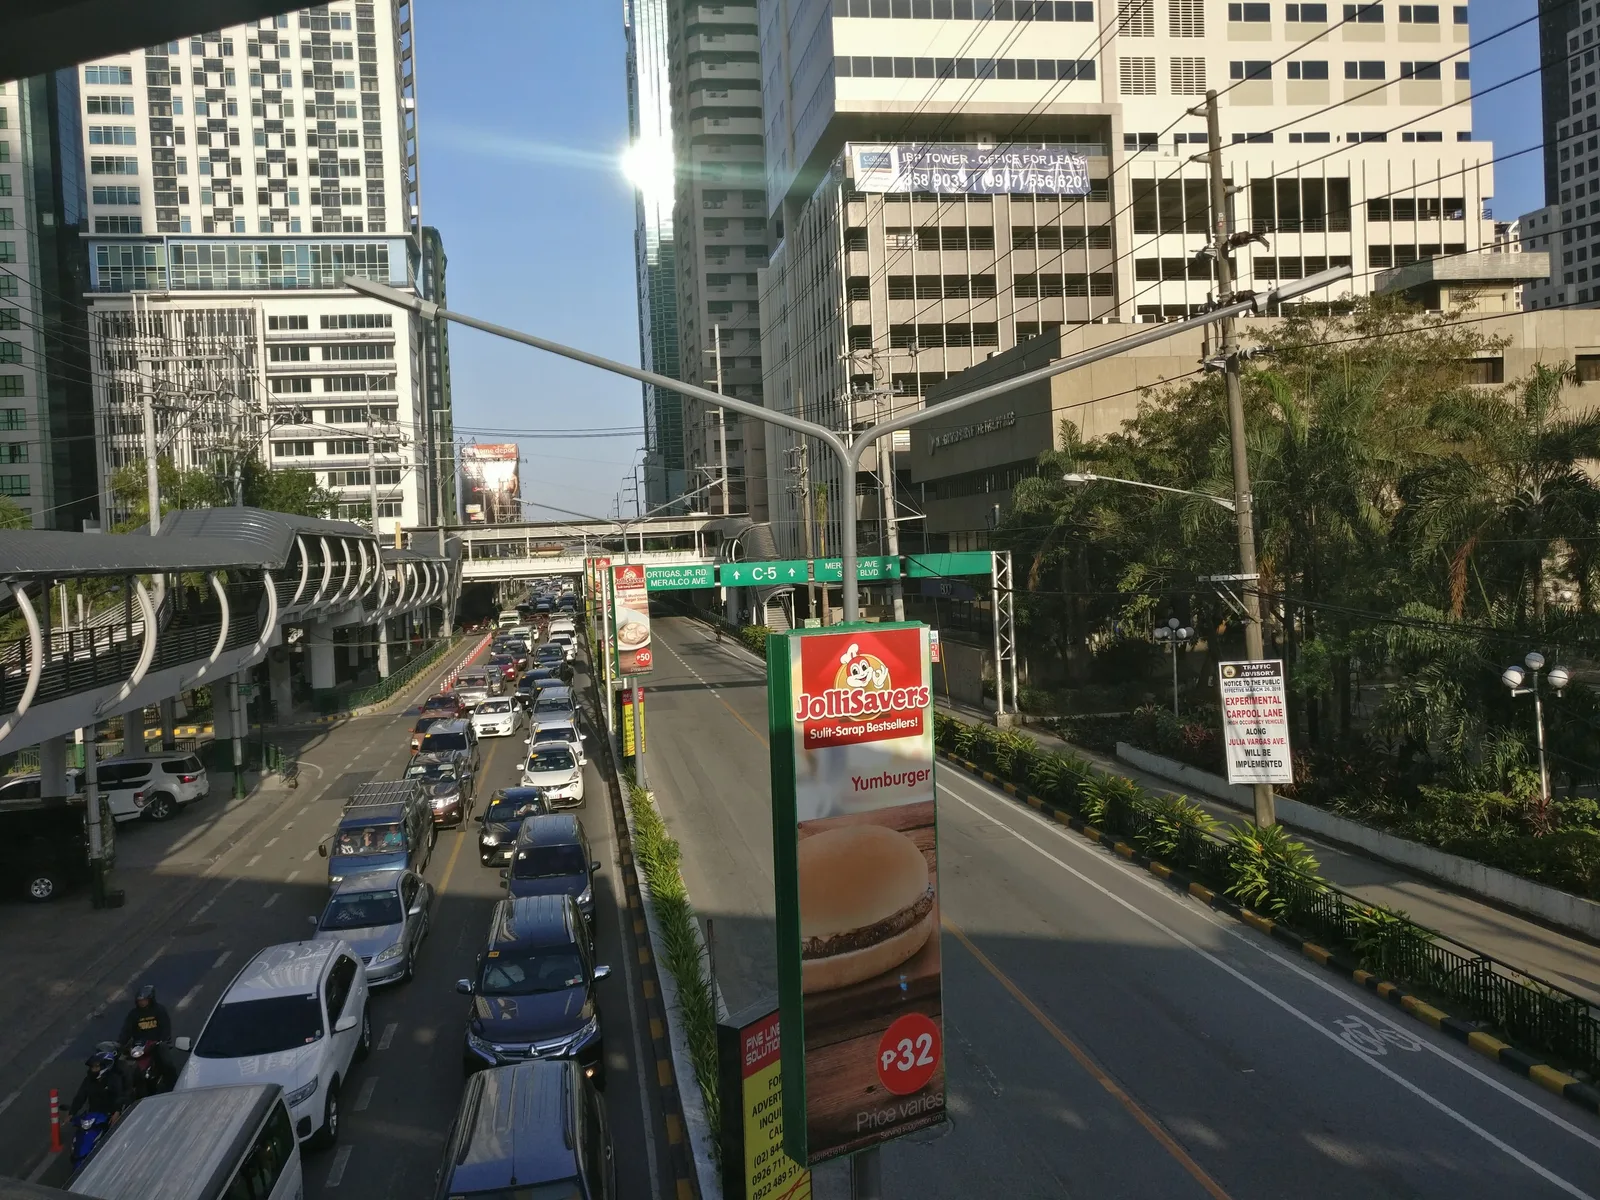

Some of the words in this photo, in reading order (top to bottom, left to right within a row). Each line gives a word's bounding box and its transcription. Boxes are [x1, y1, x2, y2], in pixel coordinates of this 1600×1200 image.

[902, 153, 921, 163] IBP
[925, 153, 968, 165] TOWER
[978, 153, 1020, 165] OFFICE
[1023, 154, 1047, 164] FOR
[1050, 154, 1085, 165] LEASE
[683, 569, 694, 577] JR.
[695, 568, 708, 576] RD.
[752, 566, 777, 580] C-5
[651, 578, 690, 587] MERALCO
[692, 577, 708, 585] AVE.
[795, 685, 931, 722] JolliSavers
[1225, 696, 1282, 706] EXPERIMENTAL
[1226, 709, 1261, 718] CARPOOL
[1263, 708, 1283, 717] LANE
[810, 725, 865, 739] Sulit-Sarap
[866, 717, 918, 733] Bestsellers!
[1228, 738, 1245, 746] JULIA
[1272, 737, 1286, 745] AVE.
[1244, 749, 1261, 757] WILL
[1235, 760, 1283, 768] IMPLEMENTED
[852, 768, 930, 792] Yumburger
[746, 1031, 763, 1052] FINE
[765, 1021, 780, 1041] LINE
[746, 1036, 780, 1066] SOLUTIO
[856, 1107, 896, 1132] Price
[899, 1092, 944, 1117] varies
[880, 1123, 902, 1139] Serving
[754, 1149, 768, 1169] (02)
[752, 1166, 771, 1186] 0926
[773, 1155, 786, 1170] 711
[752, 1182, 772, 1200] 0922
[773, 1171, 787, 1189] 489
[788, 1163, 801, 1179] 51
